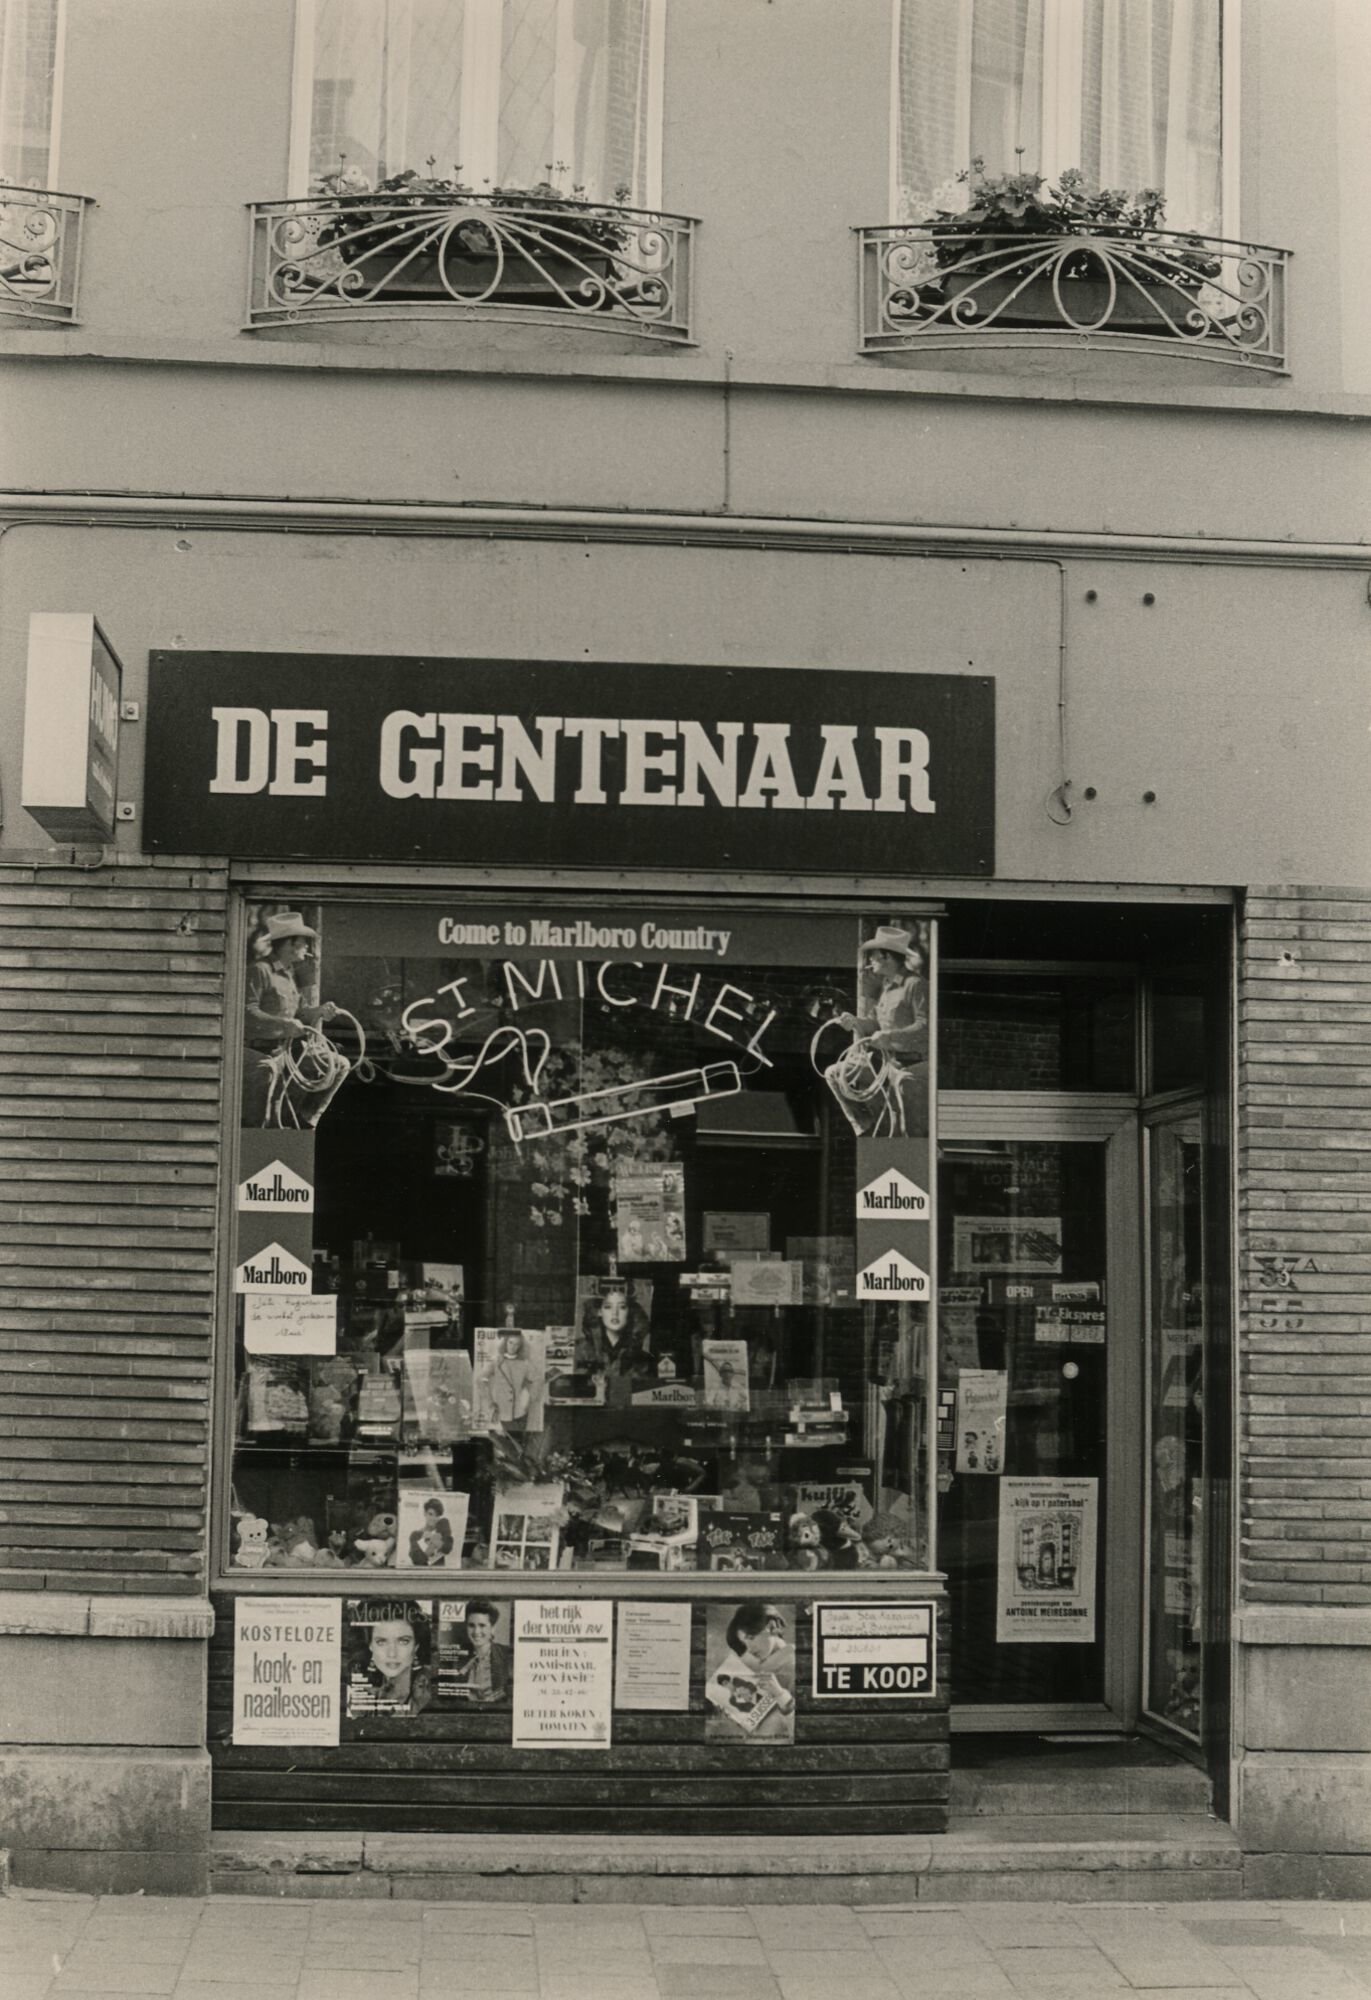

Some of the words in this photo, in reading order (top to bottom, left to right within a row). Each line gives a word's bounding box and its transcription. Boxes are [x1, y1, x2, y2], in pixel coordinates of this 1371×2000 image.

[210, 706, 329, 798] DE
[378, 709, 937, 815] GENTENAAR
[438, 917, 500, 946] Come
[503, 921, 527, 947] to
[529, 920, 637, 949] Marlboro
[640, 922, 731, 956] Country
[503, 960, 776, 1067] MICHEL
[245, 1174, 310, 1203] Marlboro
[863, 1182, 925, 1211] Marlboro
[243, 1257, 308, 1285] Marlboro
[862, 1263, 925, 1292] Marlboro
[1006, 1285, 1034, 1298] OPEN
[442, 1604, 465, 1617] RV
[540, 1604, 559, 1619] het
[562, 1605, 582, 1623] rijk
[1006, 1607, 1037, 1617] ANTOINE
[240, 1625, 335, 1642] KOSTELOZE
[523, 1620, 543, 1635] der
[546, 1623, 582, 1635] vrouw
[302, 1660, 323, 1684] en
[822, 1666, 851, 1689] TE
[863, 1666, 928, 1689] KOOP
[242, 1686, 331, 1718] naailessen
